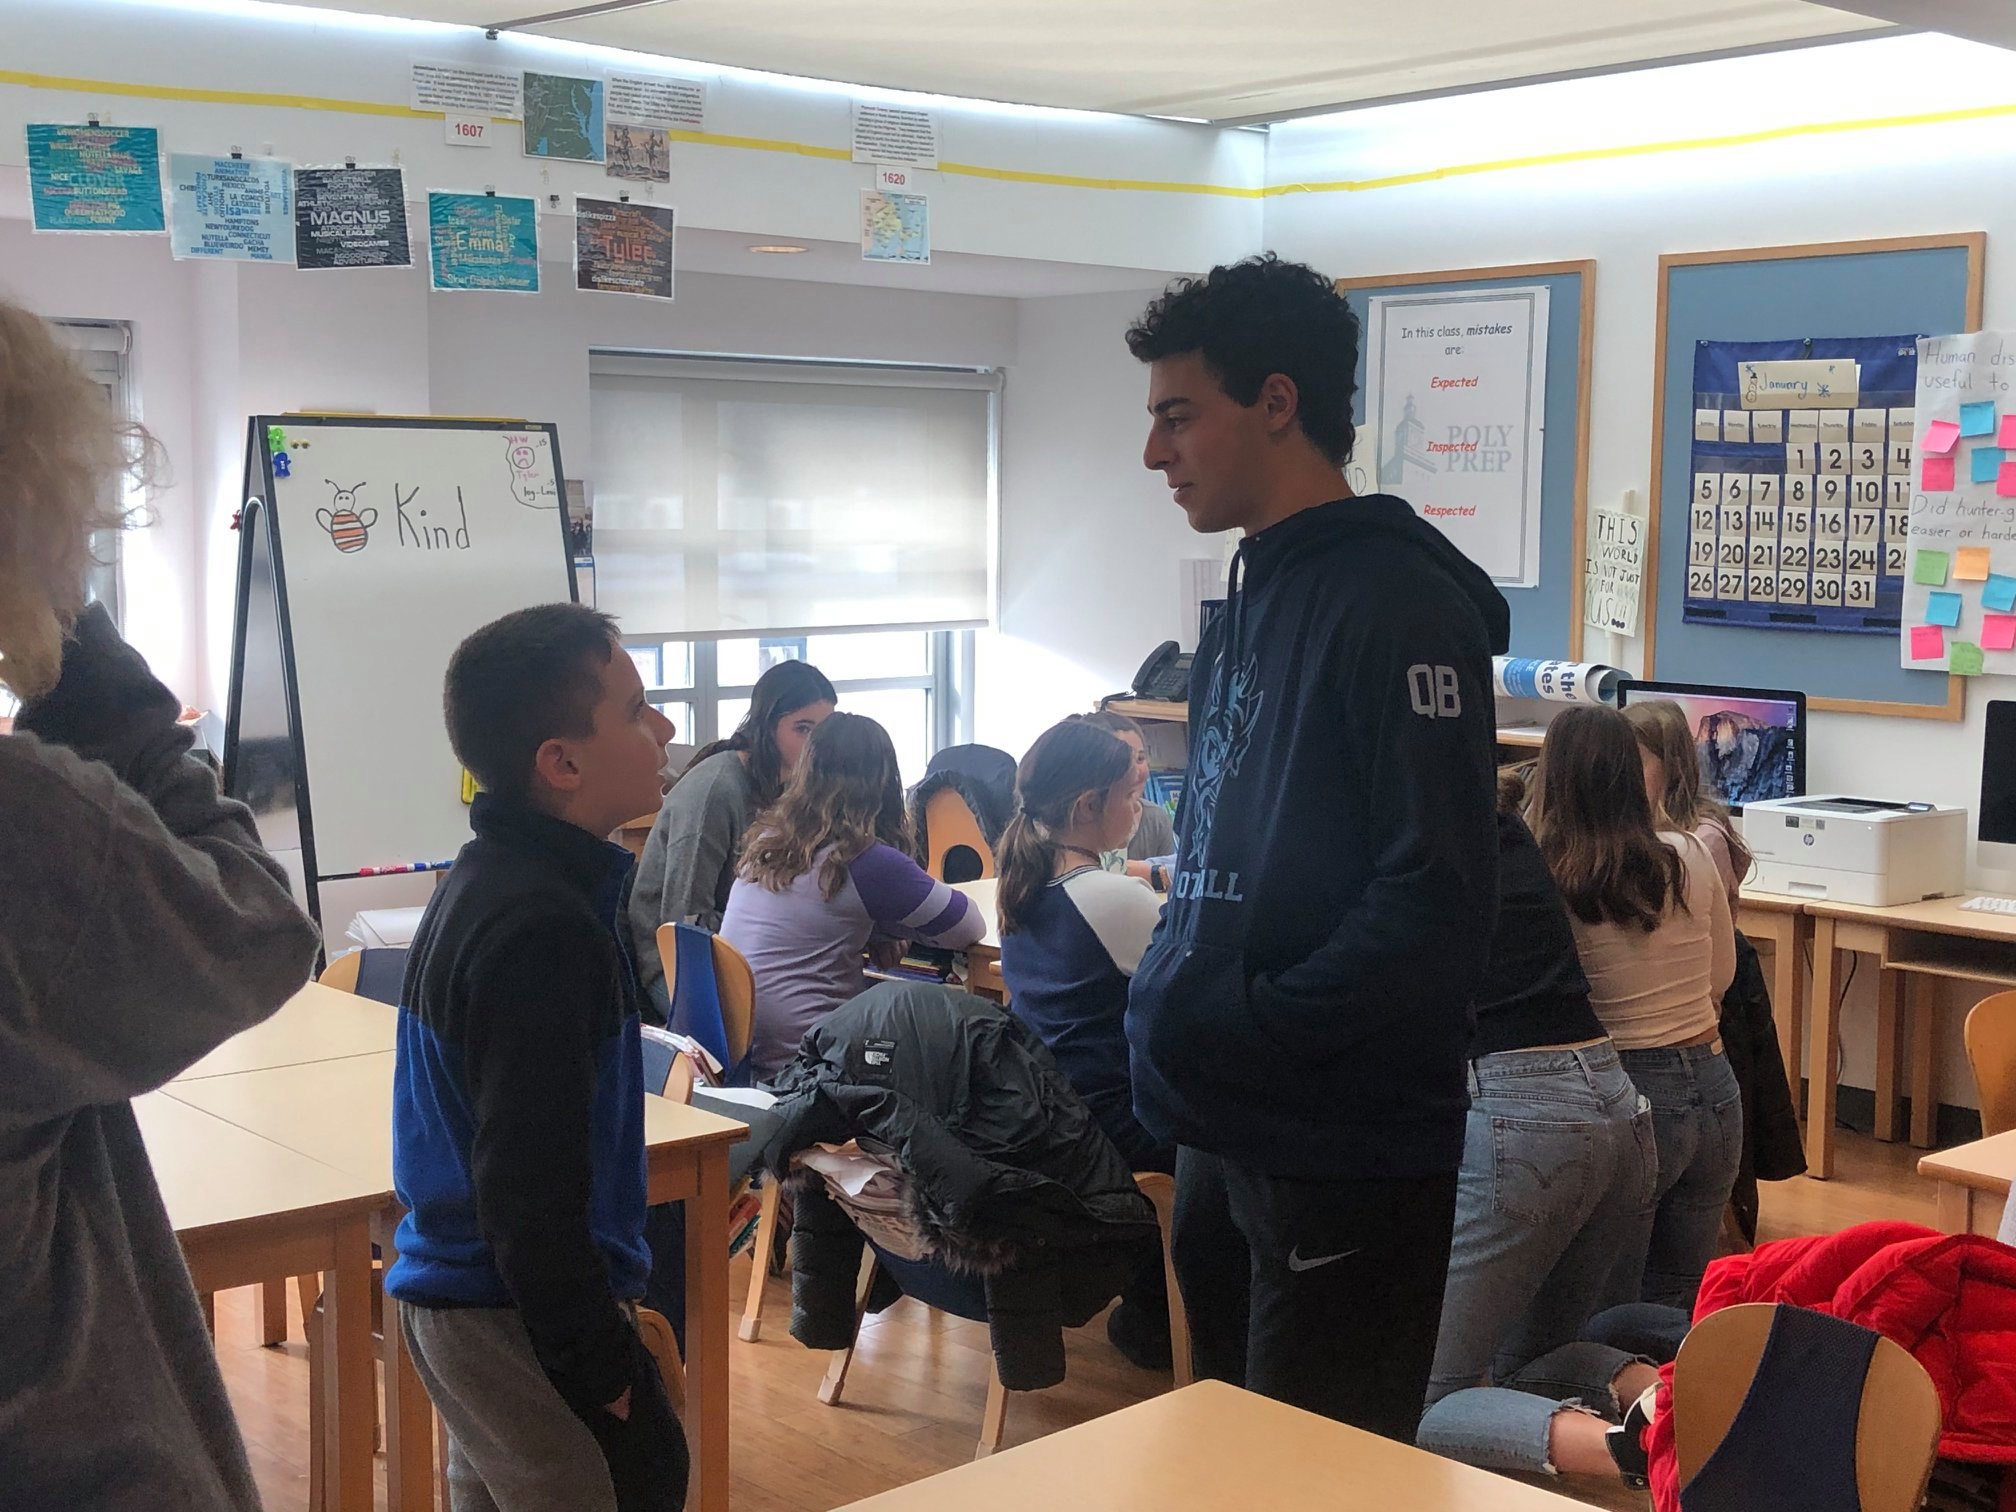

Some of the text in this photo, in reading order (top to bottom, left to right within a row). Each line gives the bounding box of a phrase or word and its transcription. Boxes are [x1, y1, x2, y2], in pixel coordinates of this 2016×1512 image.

[454, 122, 484, 138] 1607
[882, 172, 906, 185] 1620
[226, 204, 241, 216] Isa
[310, 210, 391, 226] MAGNUS
[224, 218, 259, 226] HAMPTONS
[228, 231, 271, 240] CONNECTICUT
[340, 240, 389, 248] VIDEOGAMES
[456, 230, 504, 252] Emma
[1402, 323, 1513, 339] In this class, mistakes
[1925, 341, 1976, 365] Human
[1430, 376, 1479, 391] Expected
[1759, 373, 1809, 401] January
[1925, 369, 2010, 392] useful to
[1446, 425, 1514, 448] POLY
[1426, 441, 1478, 455] Inspected
[1797, 448, 1910, 469] 1 2 3 4
[1445, 450, 1513, 473] PREP
[1701, 480, 1712, 499] 5
[1729, 479, 1741, 499] 6
[1760, 481, 1771, 500] 7
[1793, 481, 1805, 501] 8
[1824, 481, 1838, 501] 9
[1856, 482, 1879, 502] 10
[394, 482, 471, 550] Kind
[1423, 503, 1477, 518] Respected
[1911, 494, 2015, 522] Did hunter-g
[1598, 514, 1637, 545] THIS
[1695, 510, 1908, 536] 12 13 14 15 16 17 18
[1911, 523, 2016, 541] easier or harde
[1602, 546, 1639, 565] WORLD
[1694, 541, 1712, 561] 19
[1721, 544, 1744, 564] 20
[1753, 545, 1773, 565] 21
[1782, 546, 1807, 567] 22
[1816, 547, 1842, 568] 23
[1848, 549, 1876, 570] 24
[1585, 558, 1640, 585] IS NOT JUST
[1600, 579, 1614, 594] FOR
[1690, 572, 1871, 601] 26 27 28 29 30 31
[1407, 664, 1461, 719] QB
[1561, 672, 1578, 700] the
